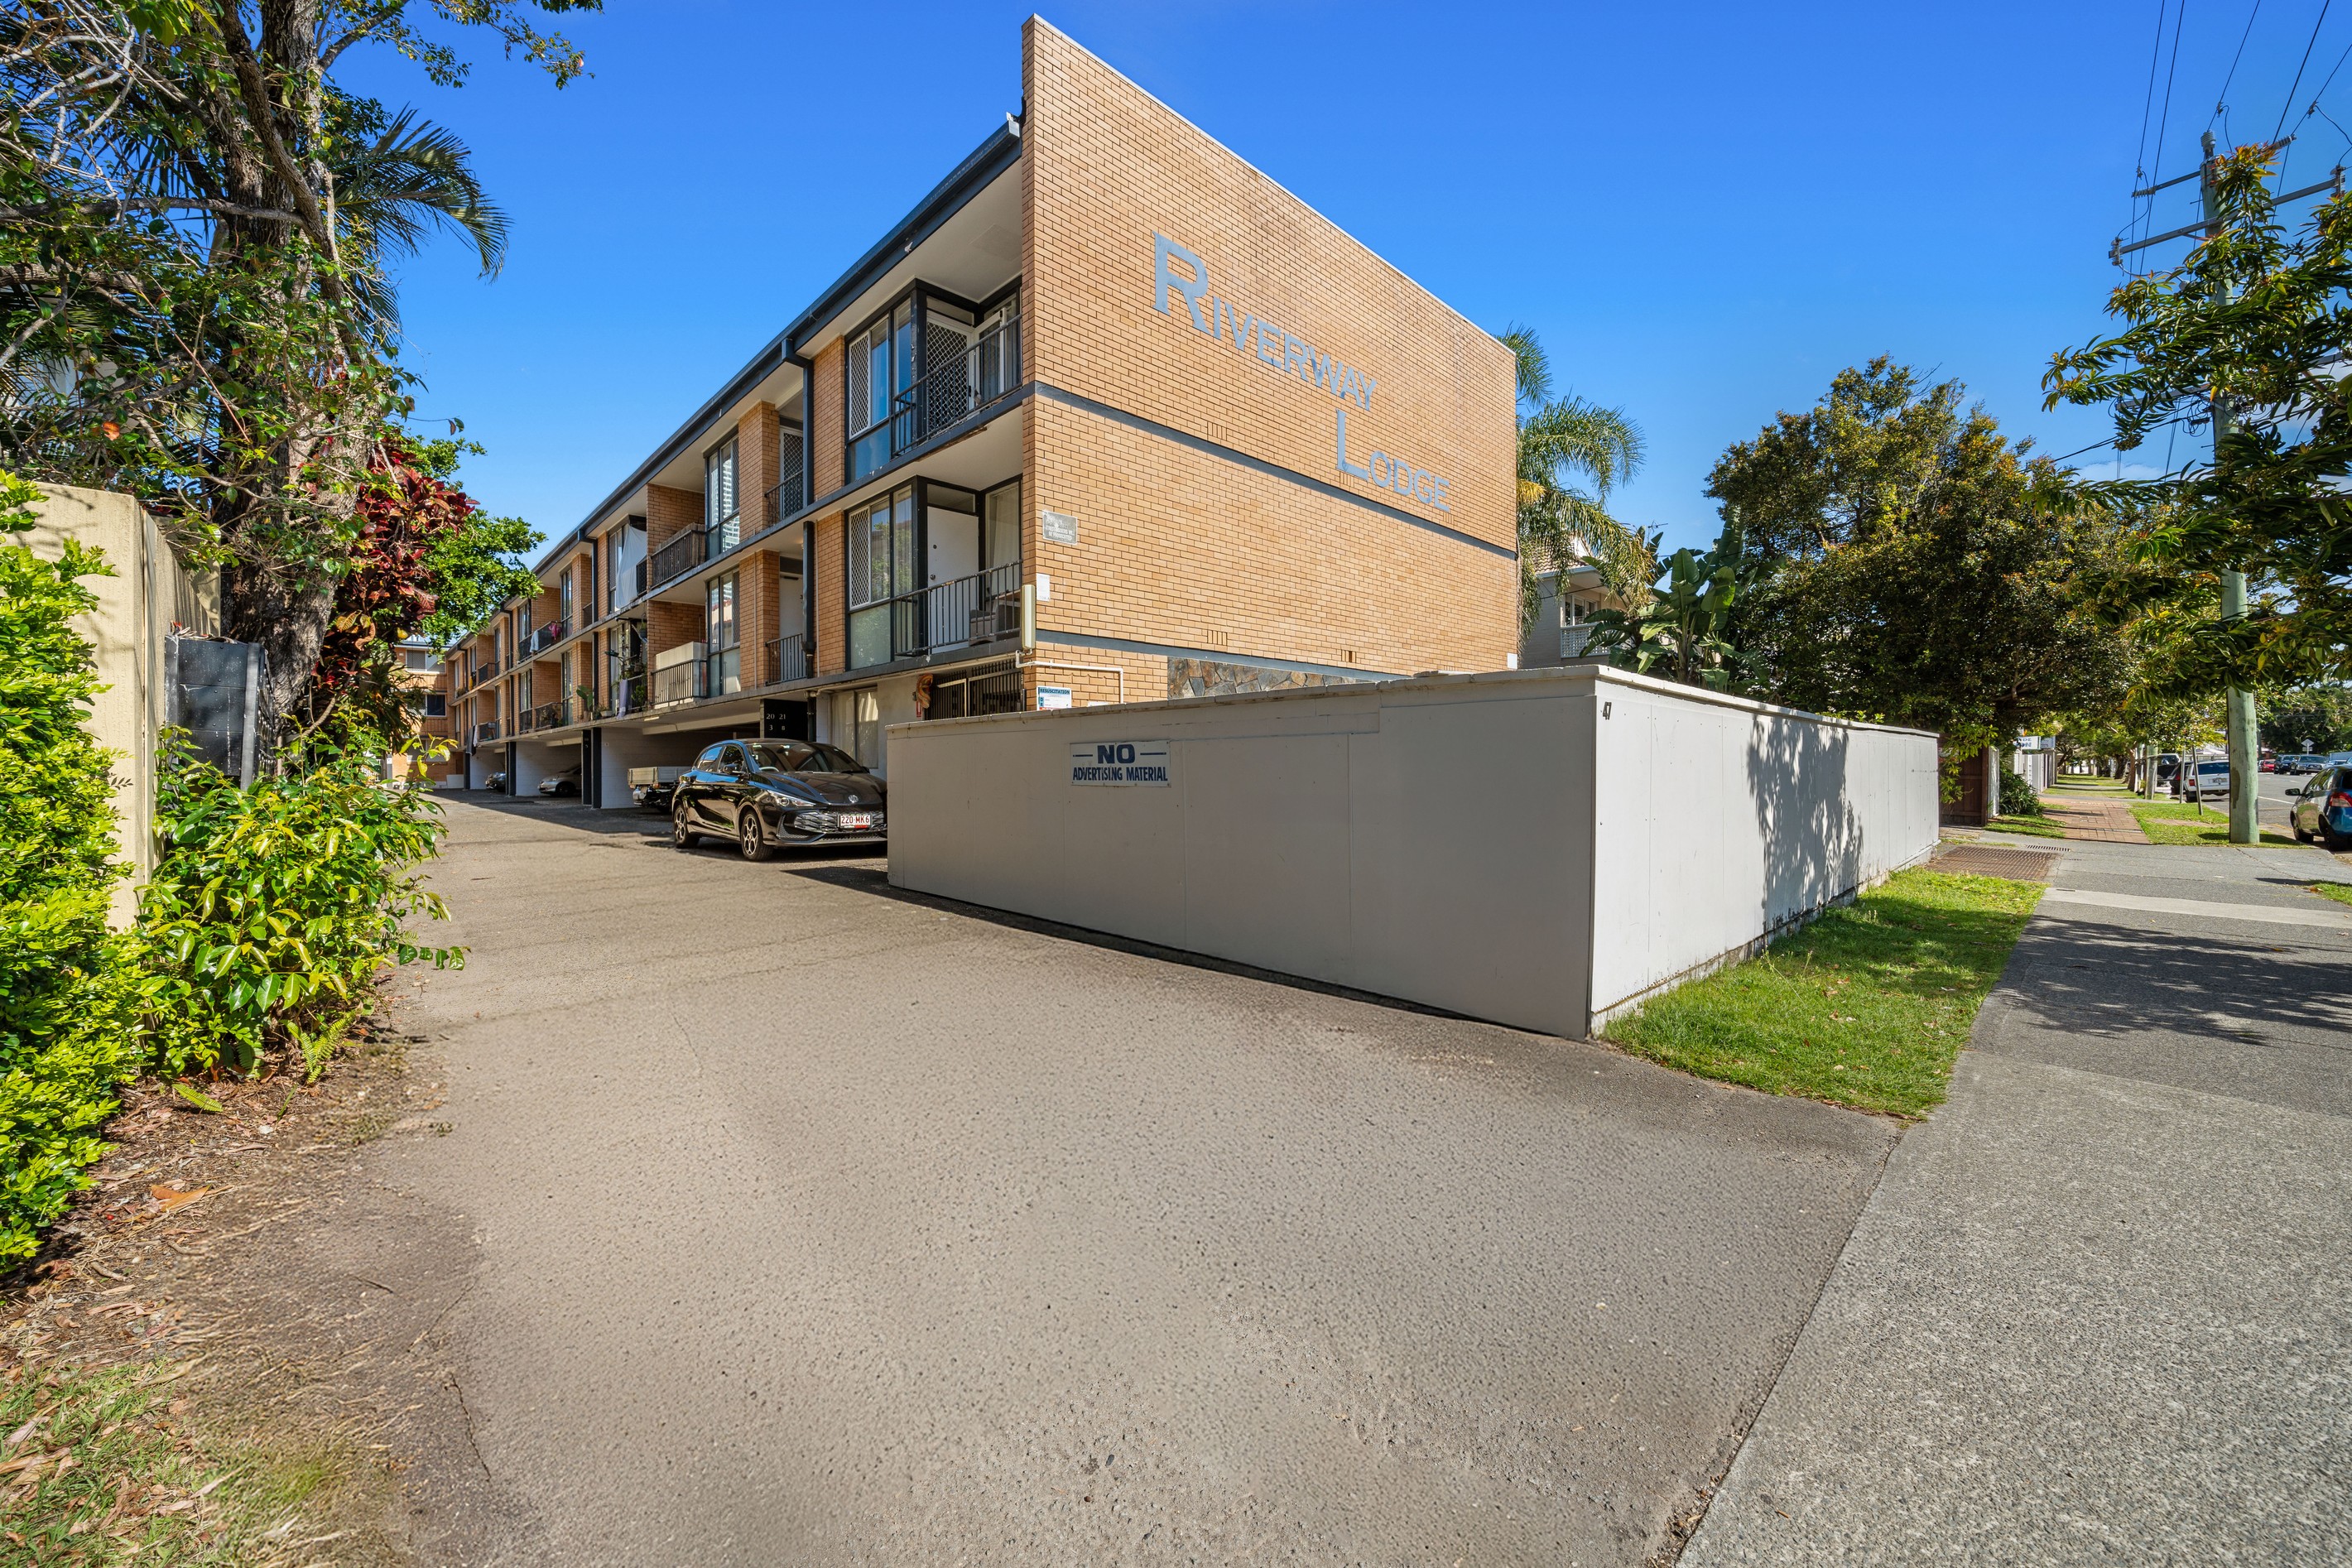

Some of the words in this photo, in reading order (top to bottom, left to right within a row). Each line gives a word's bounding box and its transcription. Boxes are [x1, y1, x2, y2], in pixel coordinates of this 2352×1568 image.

[1152, 231, 1378, 411] RIVERWAY
[1336, 408, 1450, 512] LODGE
[1072, 767, 1123, 781] ADVERTISING
[1126, 767, 1168, 781] MATERIAL
[1097, 744, 1136, 764] NO
